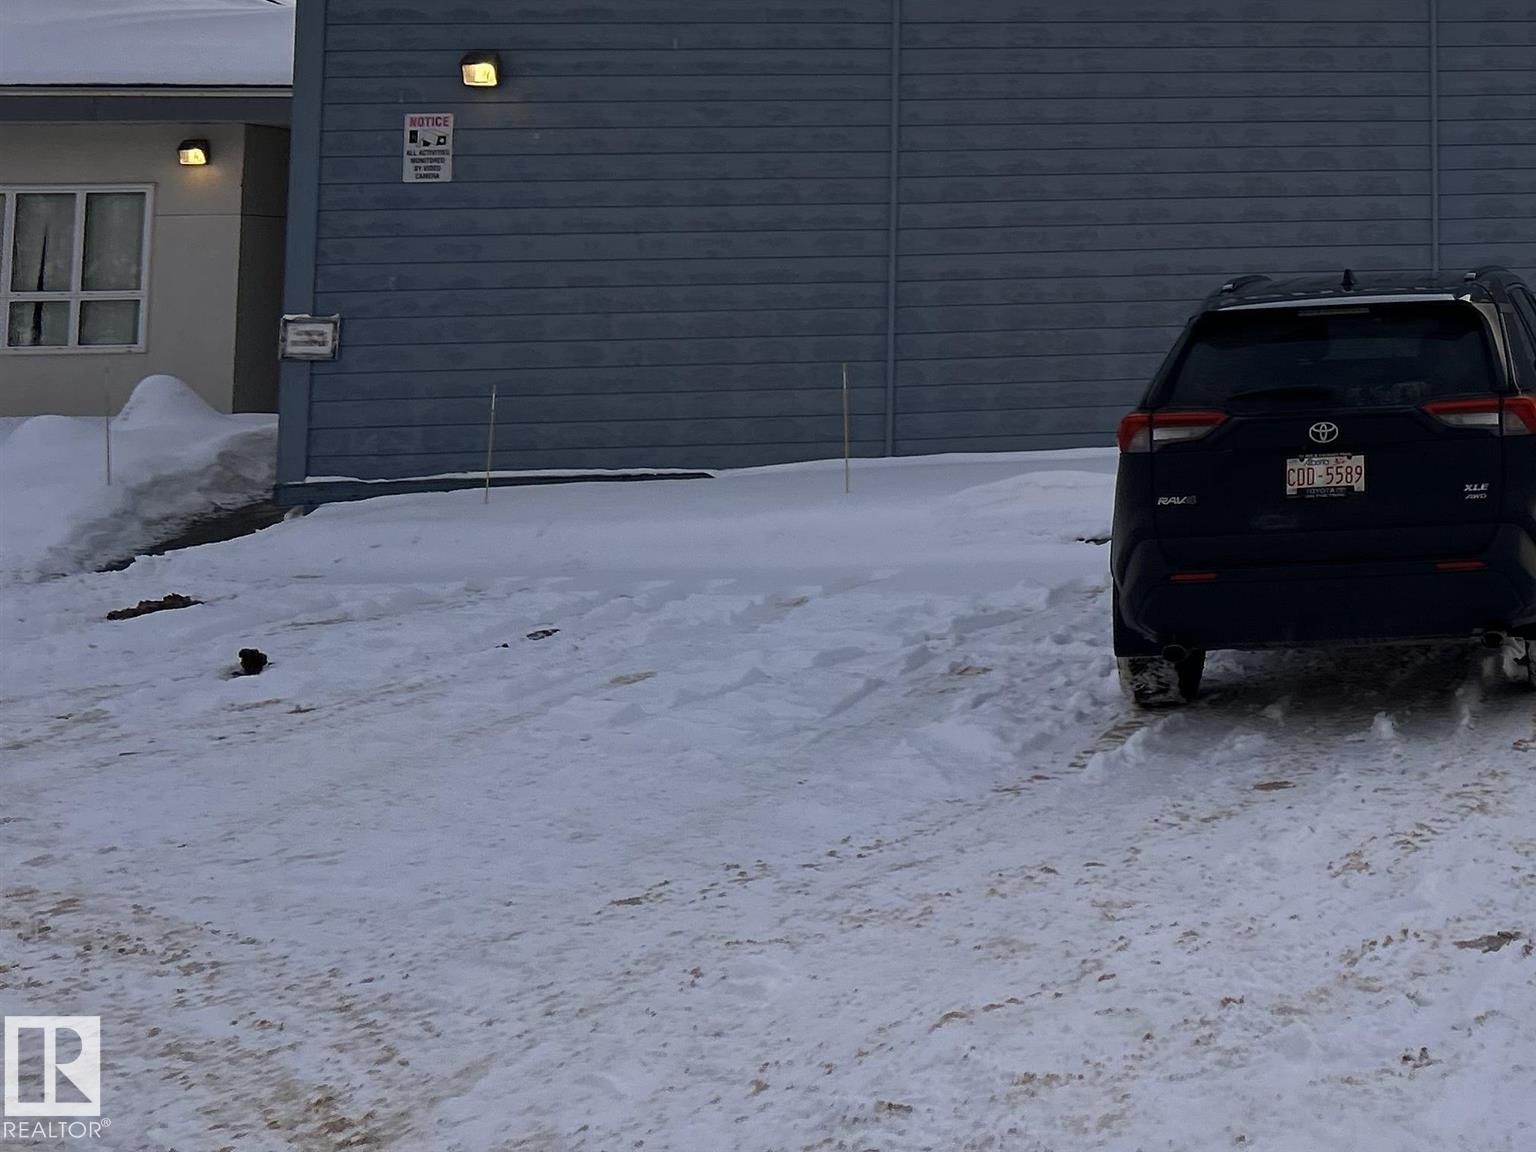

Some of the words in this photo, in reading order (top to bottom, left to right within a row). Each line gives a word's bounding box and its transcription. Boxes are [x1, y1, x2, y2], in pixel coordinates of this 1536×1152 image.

[409, 116, 449, 127] NOTICE
[1287, 465, 1363, 487] CDD-5589
[1464, 483, 1489, 491] XLE
